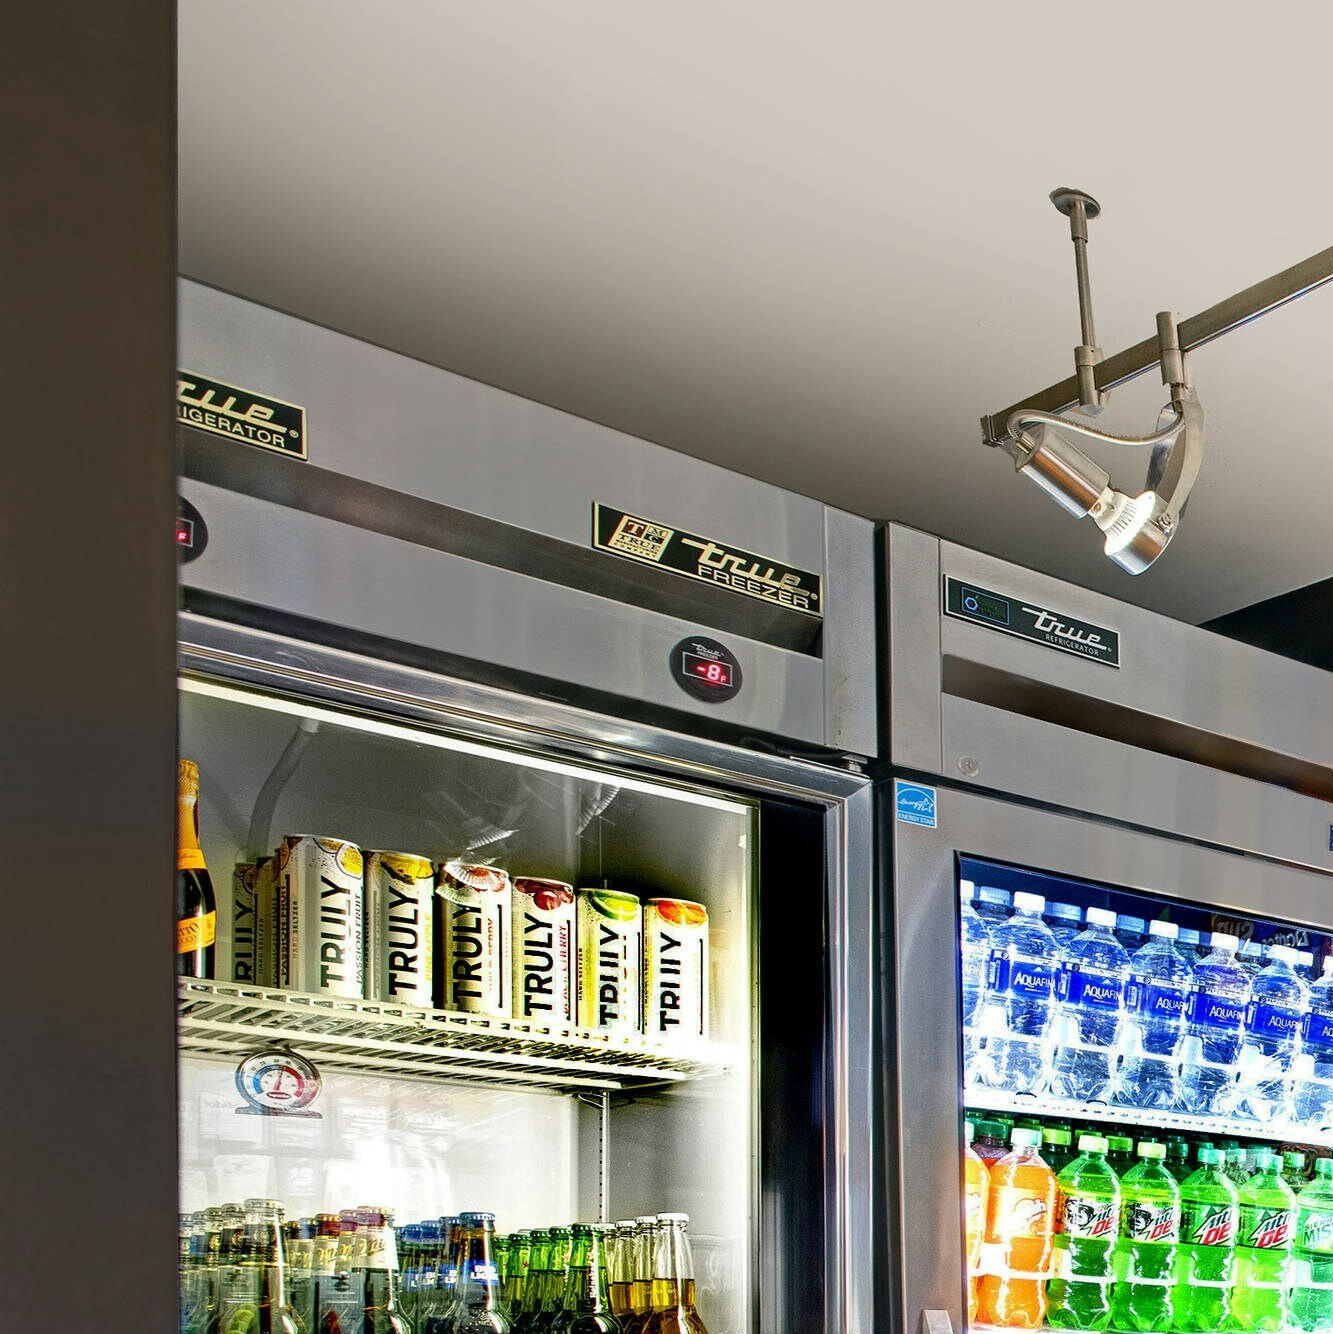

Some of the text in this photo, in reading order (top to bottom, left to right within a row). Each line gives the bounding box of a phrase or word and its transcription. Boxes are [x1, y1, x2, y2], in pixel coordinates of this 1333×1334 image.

[178, 381, 287, 433] rue
[698, 565, 810, 609] FREEZER
[1045, 634, 1100, 657] REFRIGERATOR
[388, 886, 419, 996] TRULY
[453, 905, 482, 1004] TRULY
[524, 912, 553, 1017] TRULY
